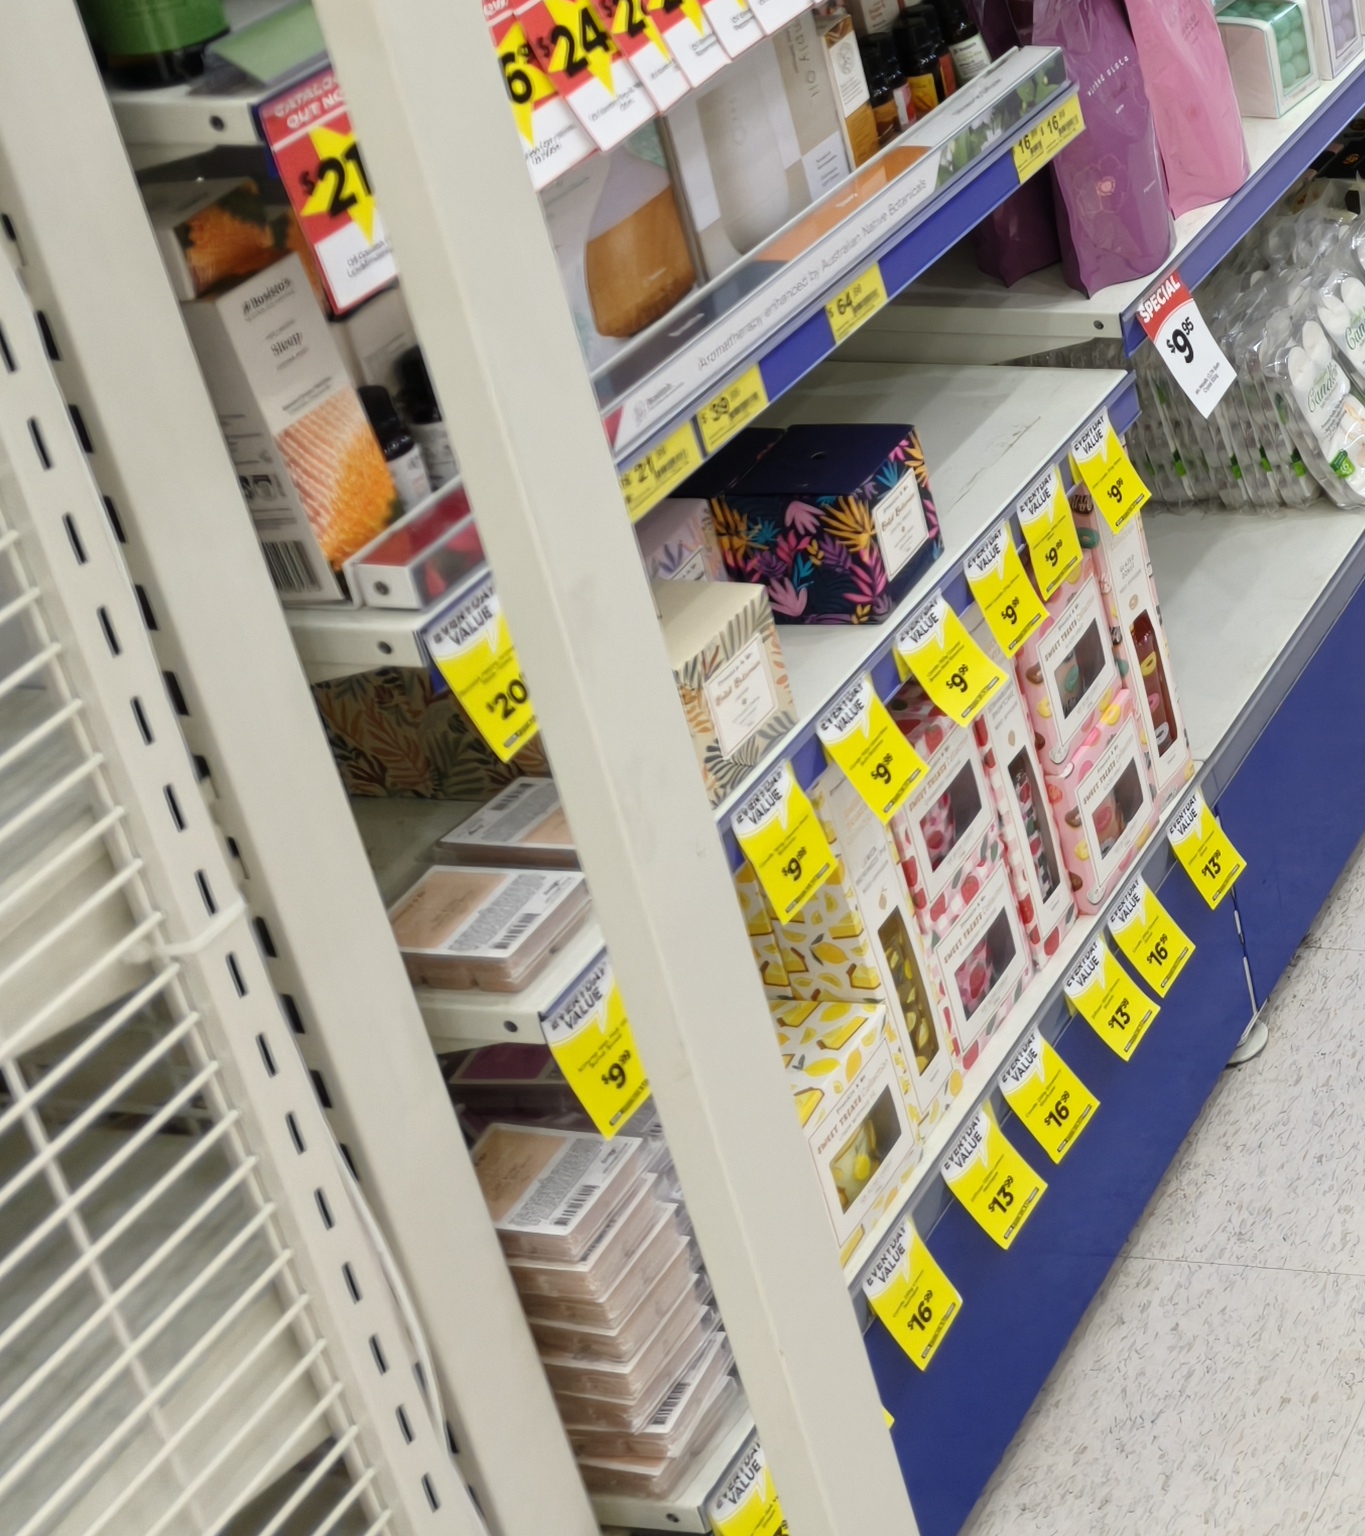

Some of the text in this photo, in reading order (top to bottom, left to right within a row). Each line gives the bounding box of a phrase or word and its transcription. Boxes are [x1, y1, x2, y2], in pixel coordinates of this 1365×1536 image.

[1139, 277, 1181, 324] SPECIAL
[1080, 433, 1106, 458] VALUE
[1026, 488, 1052, 516] VALUE
[976, 543, 1002, 572] VALUE
[451, 607, 495, 646] VALUE
[909, 611, 941, 644] VALUE
[834, 699, 866, 735] VALUE
[746, 783, 784, 826] VALUE
[1175, 808, 1198, 836] VALUE
[1117, 893, 1141, 925] VALUE
[1076, 954, 1100, 989] VALUE
[564, 989, 604, 1031] VALUE
[1012, 1047, 1039, 1084] VALUE
[954, 1129, 983, 1172] VALUE
[876, 1242, 906, 1288] VALUE
